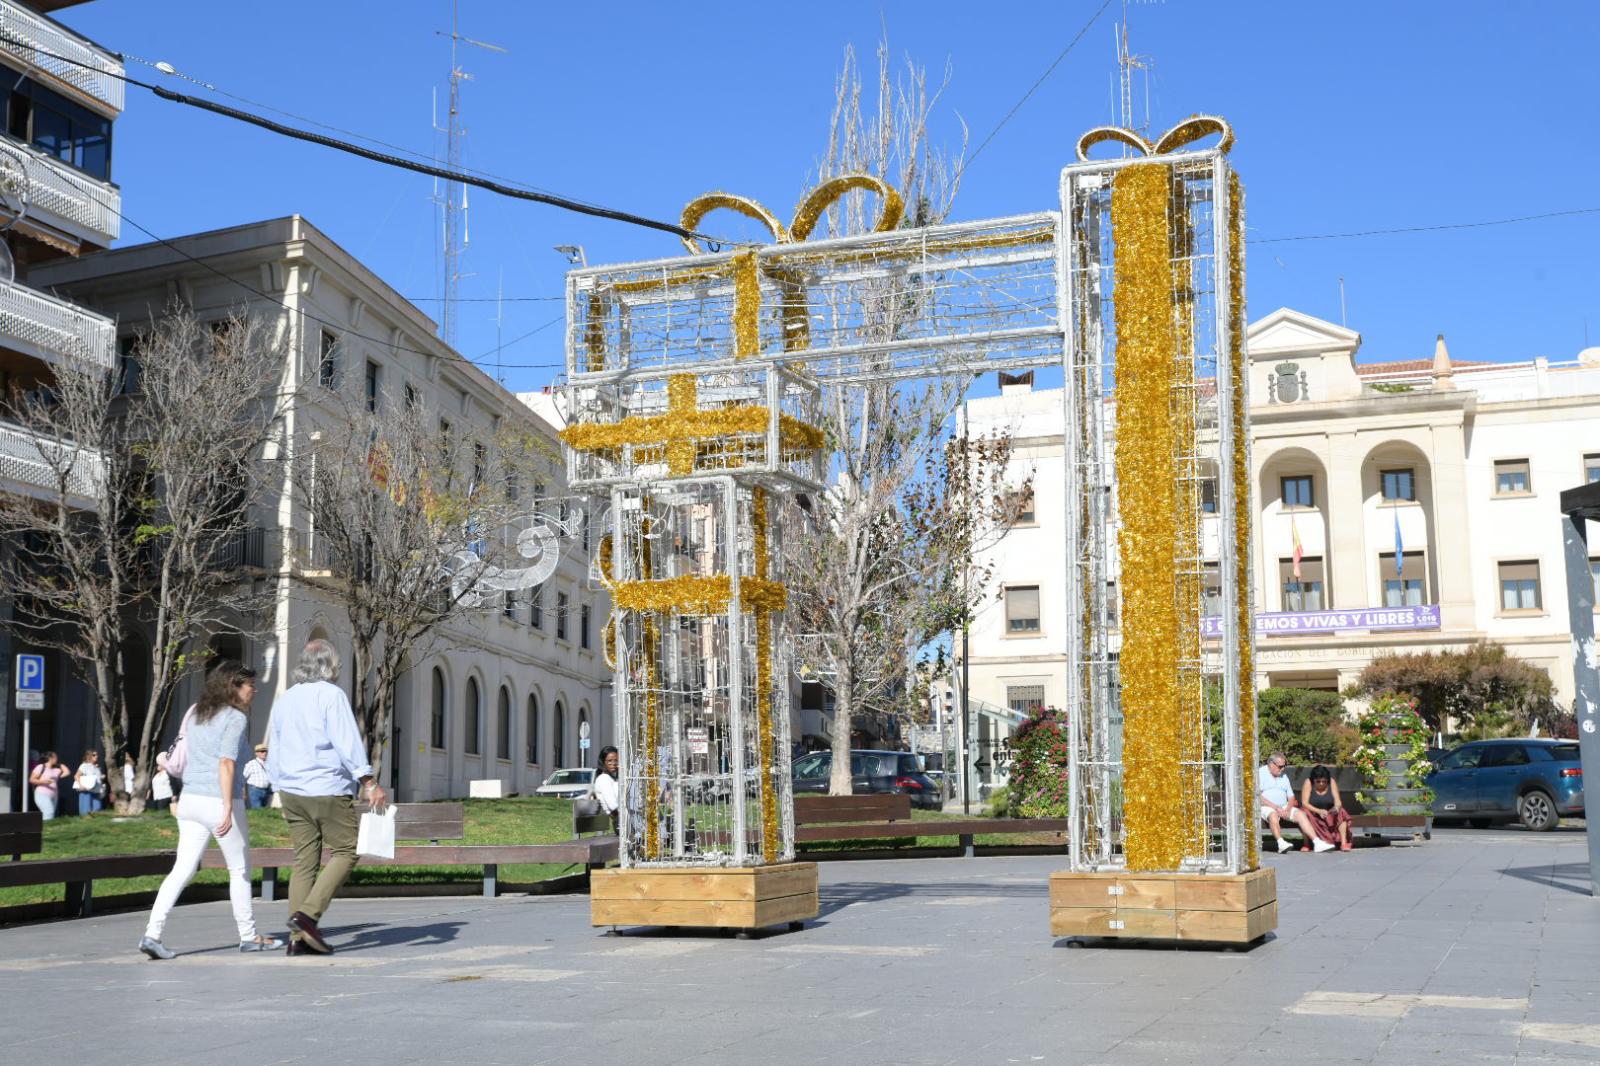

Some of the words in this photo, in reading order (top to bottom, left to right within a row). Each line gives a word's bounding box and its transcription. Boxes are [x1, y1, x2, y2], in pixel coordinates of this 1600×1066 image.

[1303, 615, 1347, 628] VIVAS
[1351, 614, 1362, 626] Y
[1366, 612, 1414, 625] LIBRES
[23, 659, 39, 687] P
